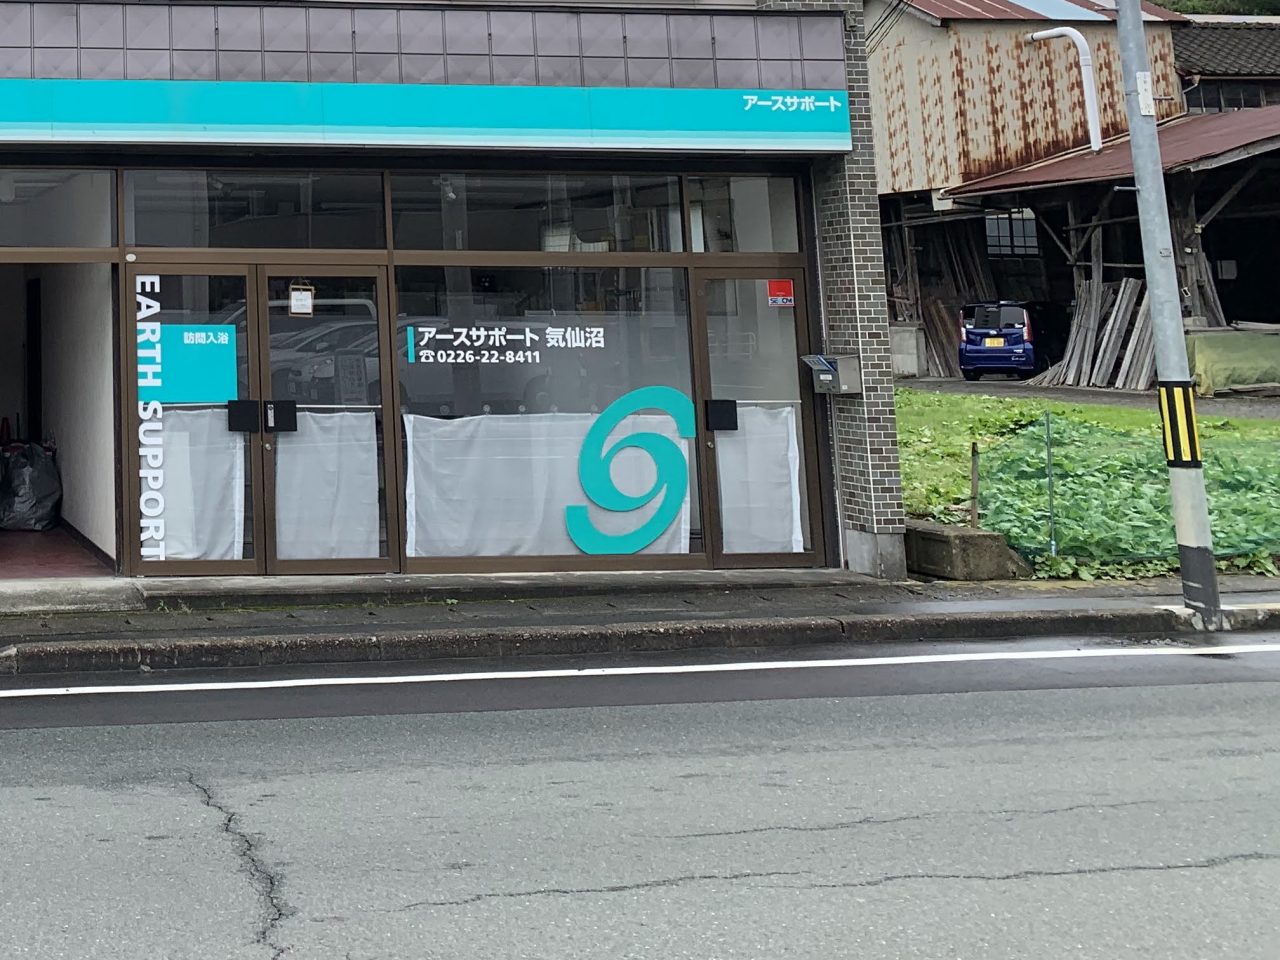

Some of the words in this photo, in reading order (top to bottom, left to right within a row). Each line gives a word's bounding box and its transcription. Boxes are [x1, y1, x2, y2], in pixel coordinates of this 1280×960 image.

[743, 95, 842, 112] アースサポート
[135, 274, 162, 388] EARTH
[183, 331, 229, 345] 訪問入浴
[418, 327, 540, 347] アースサポート
[545, 327, 605, 348] 気仙沼
[437, 350, 541, 363] 0226-22-8411
[138, 400, 166, 561] SUPPORT
